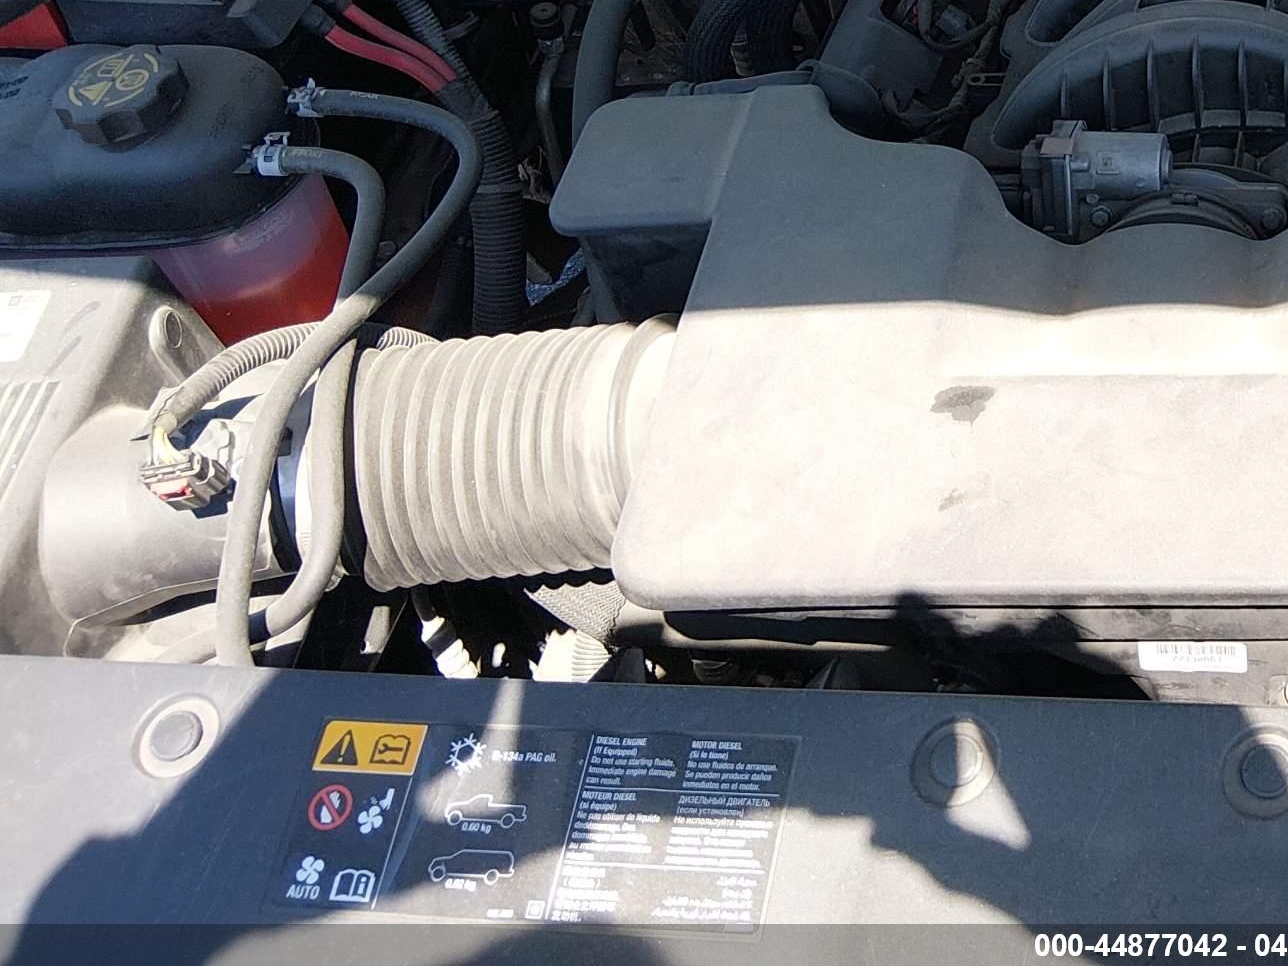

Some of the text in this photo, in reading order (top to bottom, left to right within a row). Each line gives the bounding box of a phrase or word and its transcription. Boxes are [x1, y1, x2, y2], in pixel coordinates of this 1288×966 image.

[596, 736, 648, 746] DIESEL ENGINE
[692, 740, 743, 750] MOTOR DIESEL
[525, 752, 543, 762] PAG
[591, 756, 601, 764] Do
[602, 757, 614, 765] not
[687, 760, 697, 768] No
[698, 761, 711, 769] use
[735, 762, 745, 770] de
[626, 768, 647, 776] engine
[648, 768, 677, 778] damage
[685, 770, 694, 778] Se
[695, 771, 721, 780] pueden
[581, 791, 637, 801] MOTEUR DIESEL
[678, 795, 771, 807] ДИЗЕЛЬНЫЙ ДВИГАТЕЛЬ
[480, 823, 491, 834] kg
[285, 884, 321, 900] AUTO
